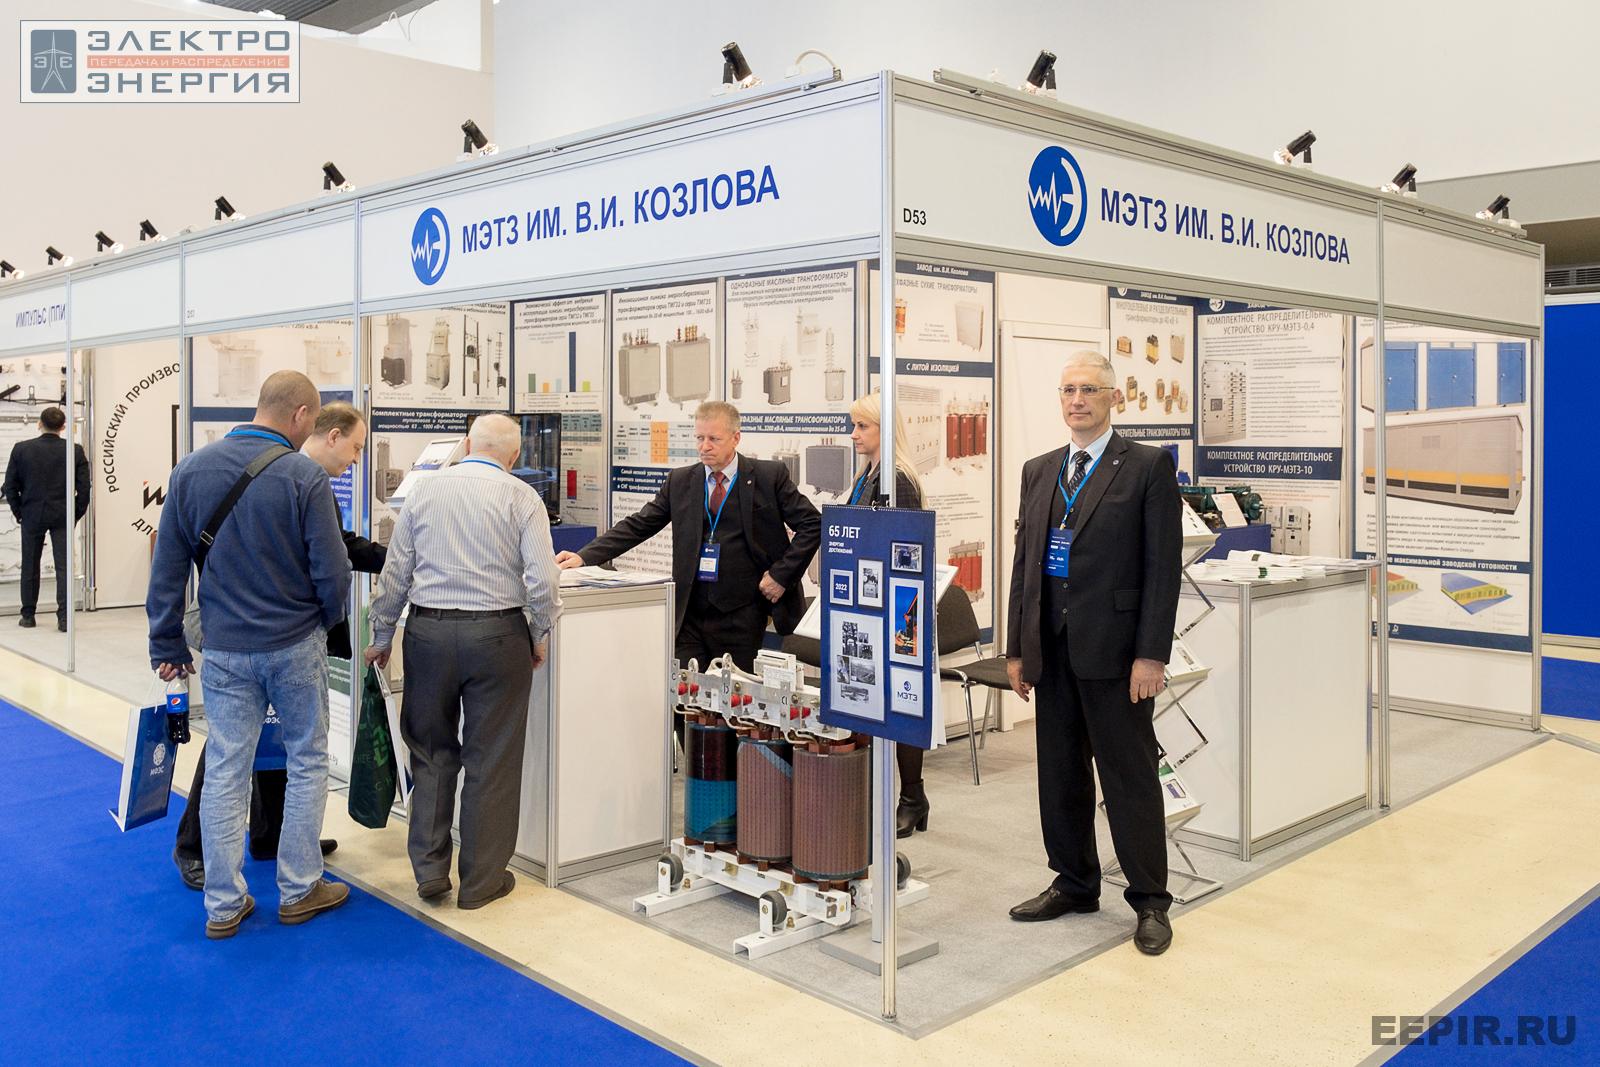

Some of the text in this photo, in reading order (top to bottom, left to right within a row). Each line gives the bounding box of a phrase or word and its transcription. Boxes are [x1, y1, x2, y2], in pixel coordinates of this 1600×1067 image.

[462, 165, 780, 253] МЭТЗ ИМ. В.И. КОЗЛОВА
[903, 207, 927, 227] D53
[1101, 188, 1350, 264] МЭТЗ ИМ. В.И. КОЗЛОВА
[730, 272, 849, 290] ОДНОФАЗНЫЕ МАСЛЯНЫЕ ТРАНСФОРМАТОРЫ
[1207, 310, 1333, 325] КОМПЛЕКТНОЕ РАСПРЕДЕЛИТЕЛЬНОЕ
[1223, 324, 1265, 335] УСТРОЙСТВО
[911, 362, 929, 372] ЛИТОЙ
[930, 363, 960, 373] ИЗОЛЯЦИЕЙ
[372, 409, 415, 417] Комплектные
[765, 415, 794, 423] МАСЛЯНЫЕ
[795, 416, 847, 424] ТРАНСФОРМАТОРЫ
[101, 403, 128, 493] РОССИЙСКИЙ
[1207, 450, 1333, 462] КОМПЛЕКТНОЕ РАСПРЕДЕЛИТЕЛЬНОЕ
[1223, 463, 1313, 474] УСТРОЙСТВО КРУ-МЭТЗ-10
[829, 525, 861, 539] 65 ЛЕТ
[1394, 556, 1440, 567] максимальной
[1442, 559, 1476, 569] заводской
[1478, 562, 1518, 571] готовности
[897, 691, 918, 702] МЭТЗ
